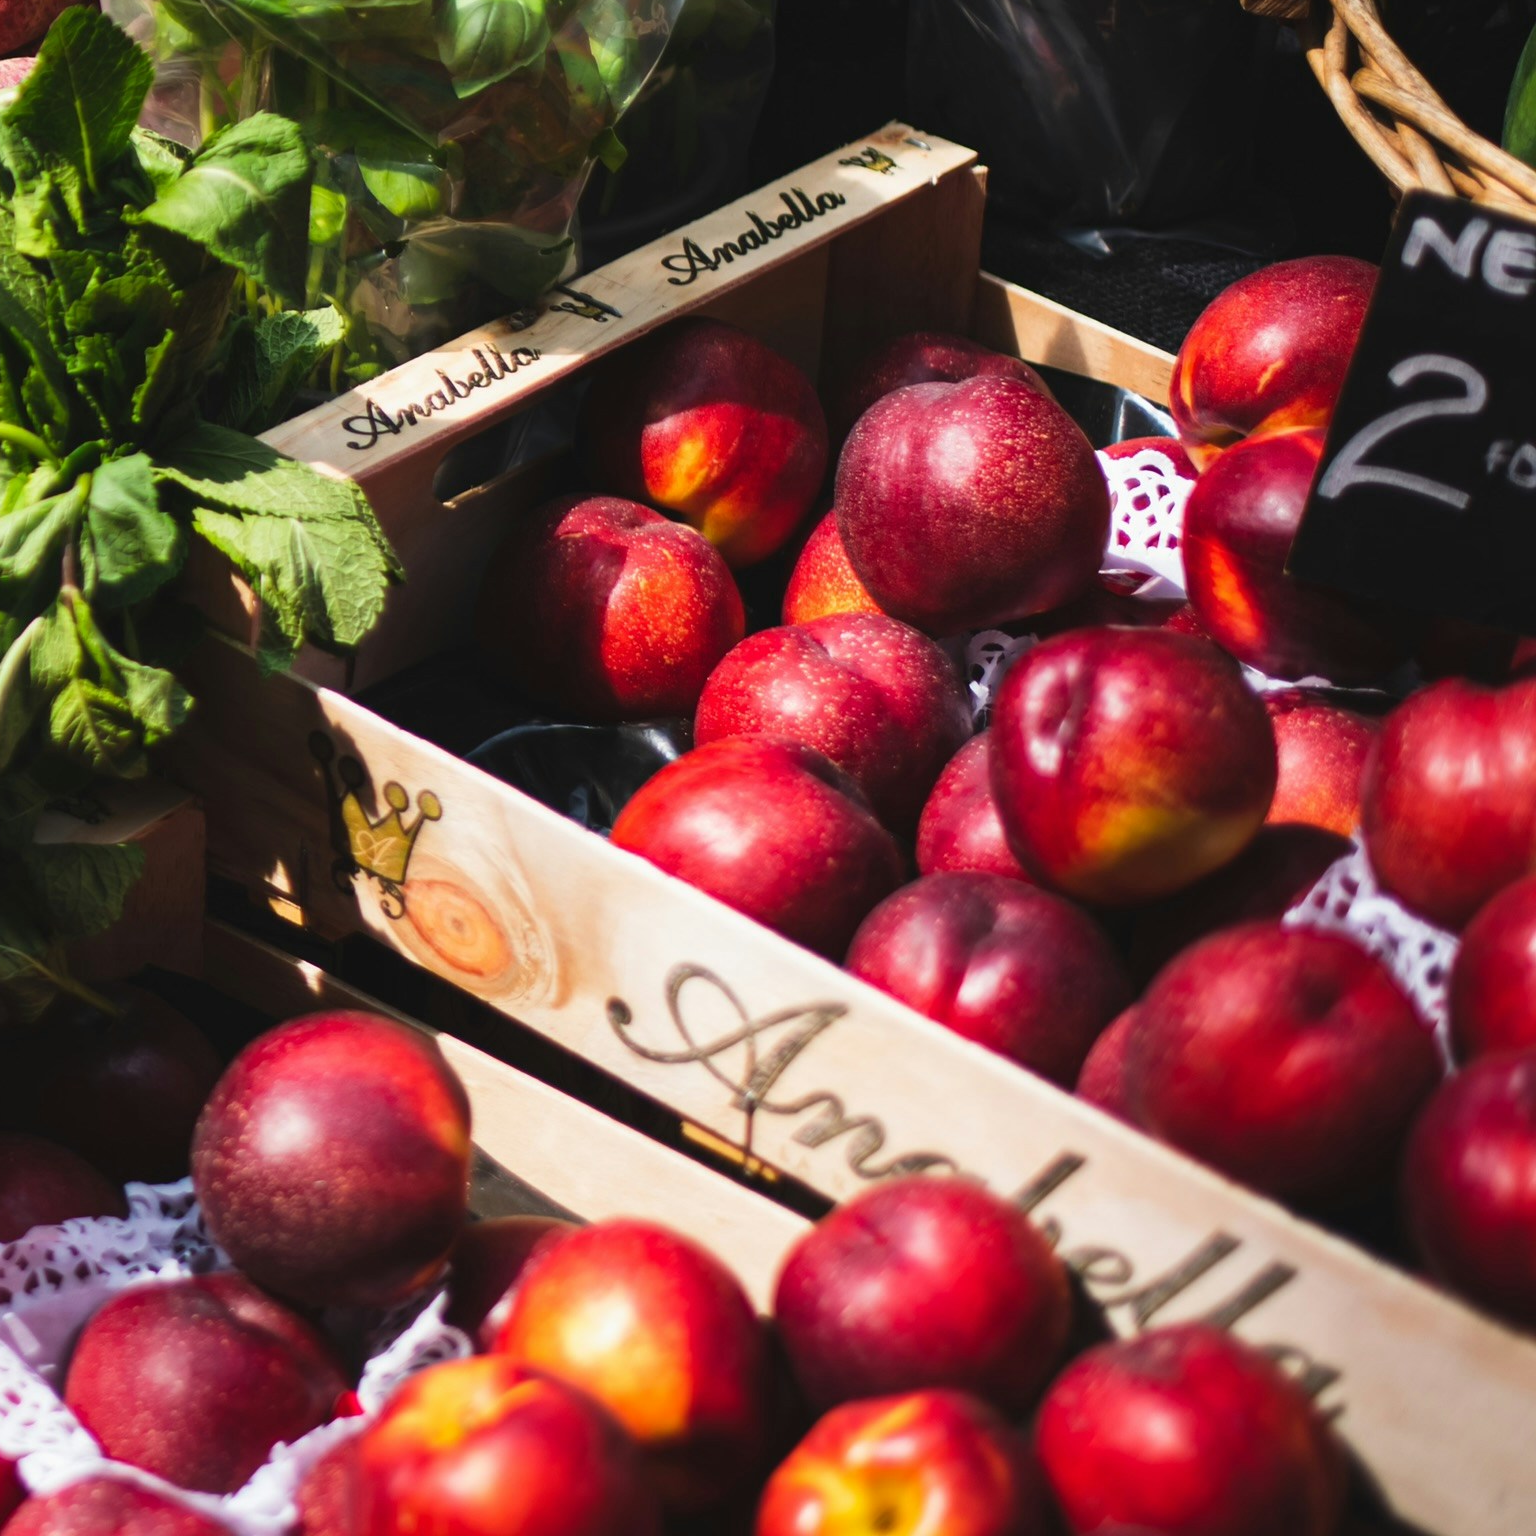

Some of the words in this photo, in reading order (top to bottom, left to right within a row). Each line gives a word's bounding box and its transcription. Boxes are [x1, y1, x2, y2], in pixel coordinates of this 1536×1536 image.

[660, 186, 846, 286] Anabella
[341, 342, 542, 451] Anabella
[1317, 353, 1487, 511] 2
